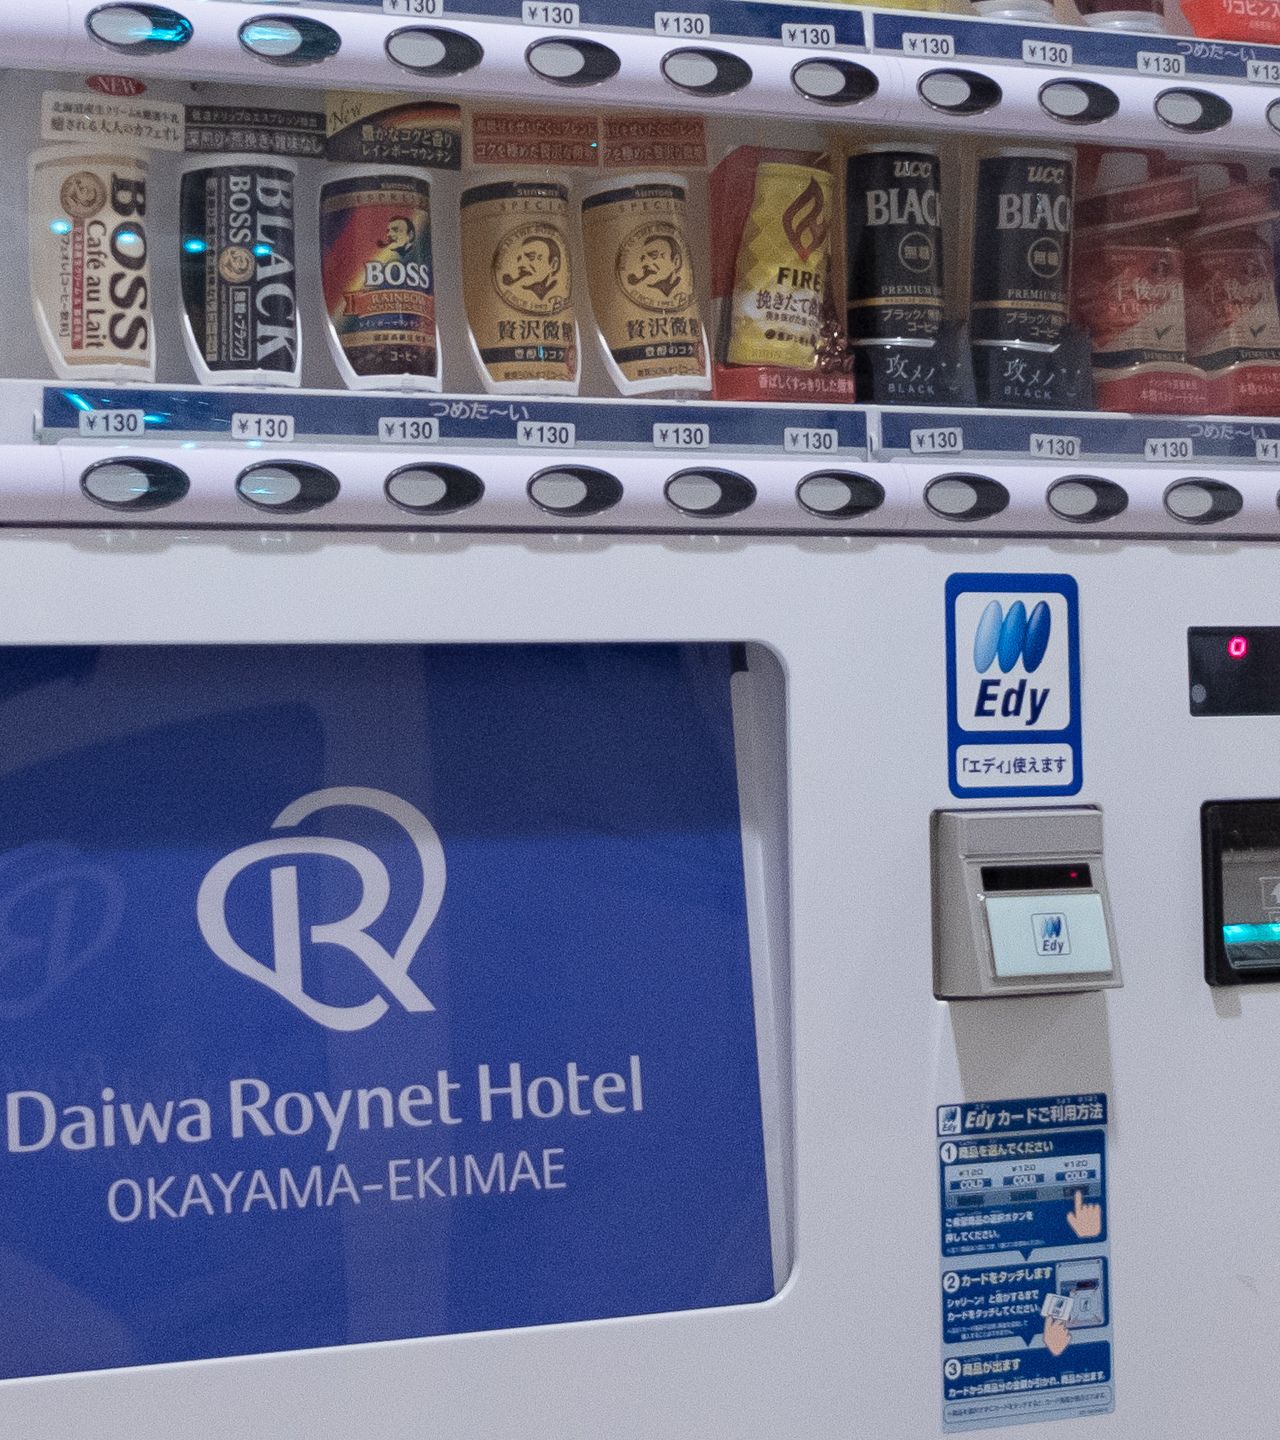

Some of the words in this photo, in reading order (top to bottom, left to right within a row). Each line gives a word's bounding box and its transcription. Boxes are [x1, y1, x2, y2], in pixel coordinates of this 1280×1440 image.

[527, 4, 574, 26] ¥130
[660, 14, 705, 35] ¥130
[787, 26, 831, 46] ¥130
[907, 36, 951, 56] ¥130
[1027, 43, 1069, 64] ¥130
[1143, 55, 1182, 75] ¥130
[98, 77, 137, 95] NEW
[228, 174, 252, 244] BOSS
[86, 218, 108, 271] Café
[108, 171, 149, 352] BOSS
[255, 173, 296, 362] BLACK
[364, 260, 431, 289] BOSS
[86, 274, 103, 304] au
[86, 308, 106, 350] Lait
[887, 382, 936, 396] BLACK
[1003, 386, 1053, 401] BLACK
[85, 413, 139, 433] ¥130
[237, 419, 289, 439] ¥130
[384, 420, 434, 441] ¥130
[523, 425, 570, 446] ¥130
[660, 426, 704, 447] ¥130
[790, 432, 834, 452] ¥130
[916, 431, 958, 450] ¥130
[1035, 437, 1076, 457] ¥130
[1150, 439, 1189, 460] ¥130
[1228, 636, 1248, 658] 0
[973, 677, 1051, 726] Edy
[961, 756, 1068, 776] 「エディ」使えます
[1041, 939, 1065, 955] Edy
[3, 1087, 215, 1156] Daiwa
[228, 1067, 463, 1153] Roynet
[477, 1053, 645, 1125] Hotel
[964, 1109, 996, 1130] Edy
[998, 1103, 1104, 1125] カードご利用方法
[959, 1178, 985, 1190] COLD
[1012, 1174, 1037, 1185] COLD
[1064, 1170, 1089, 1181] COLD
[106, 1148, 568, 1225] OKAYAMA-EKIMAE
[961, 1266, 1053, 1287] カードをタッチします
